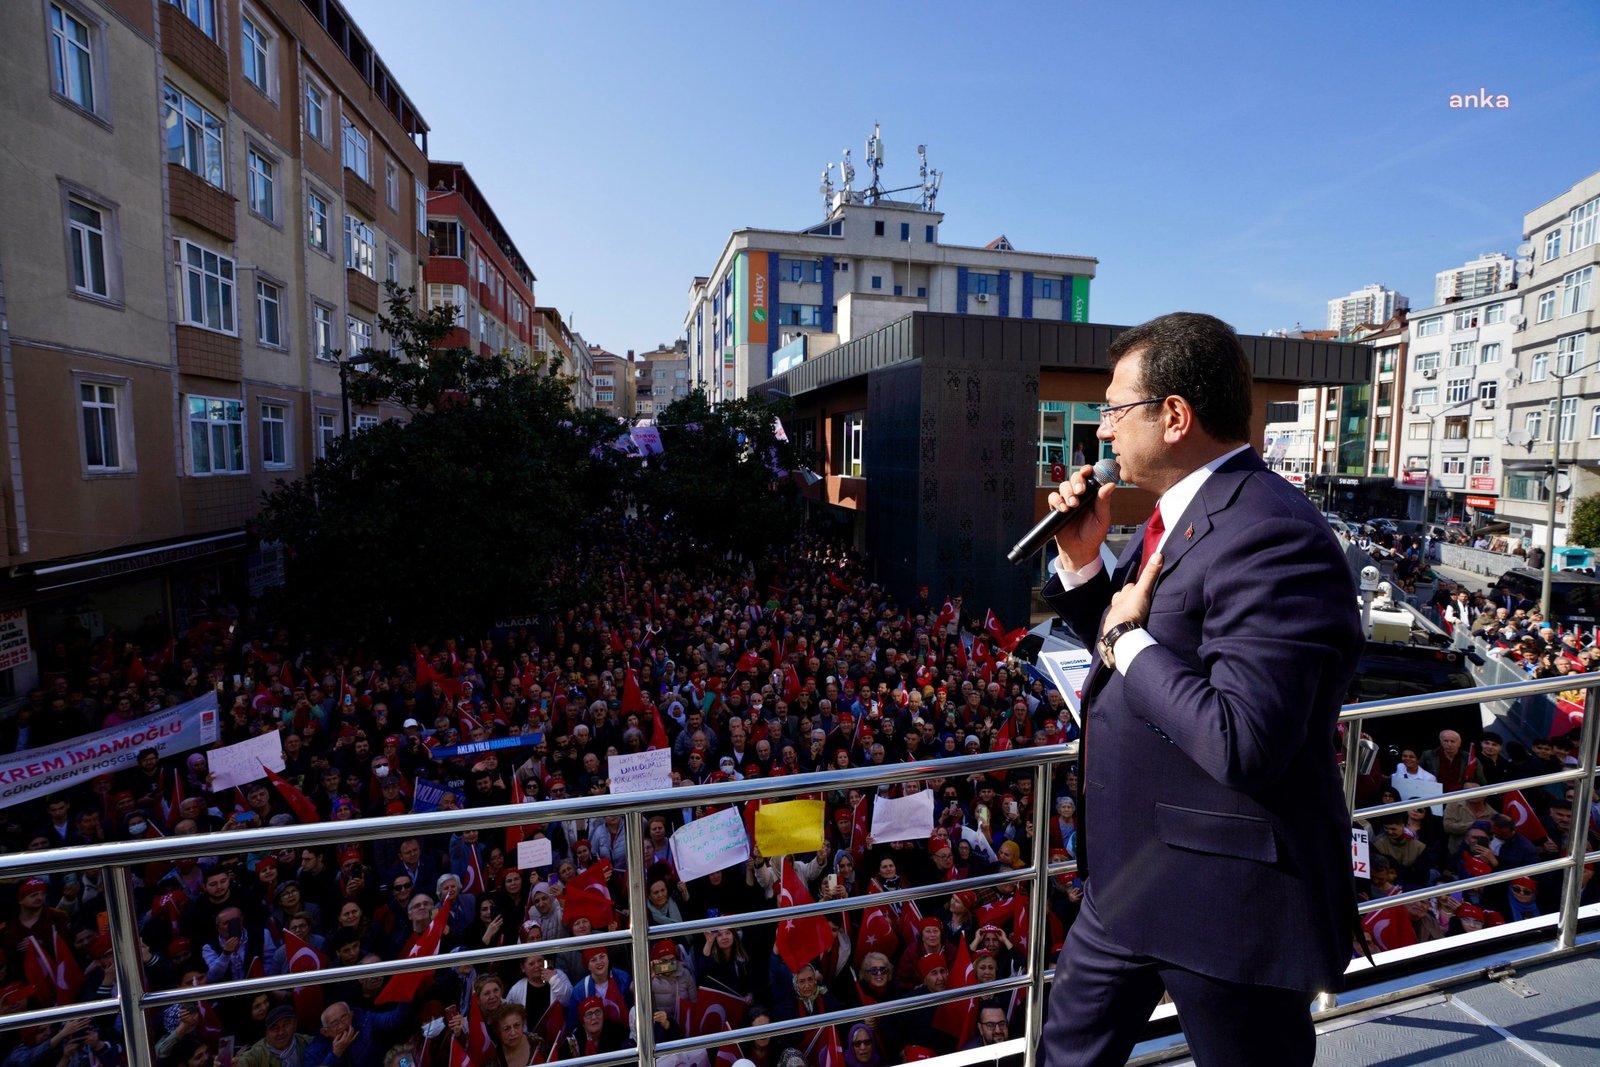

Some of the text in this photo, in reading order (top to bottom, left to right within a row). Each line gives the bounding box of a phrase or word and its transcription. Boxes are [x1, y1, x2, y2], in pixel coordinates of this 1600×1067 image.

[71, 720, 183, 766] İMAMOĞLU
[3, 742, 167, 798] GÜNGÖREN'E HOŞGELİZ
